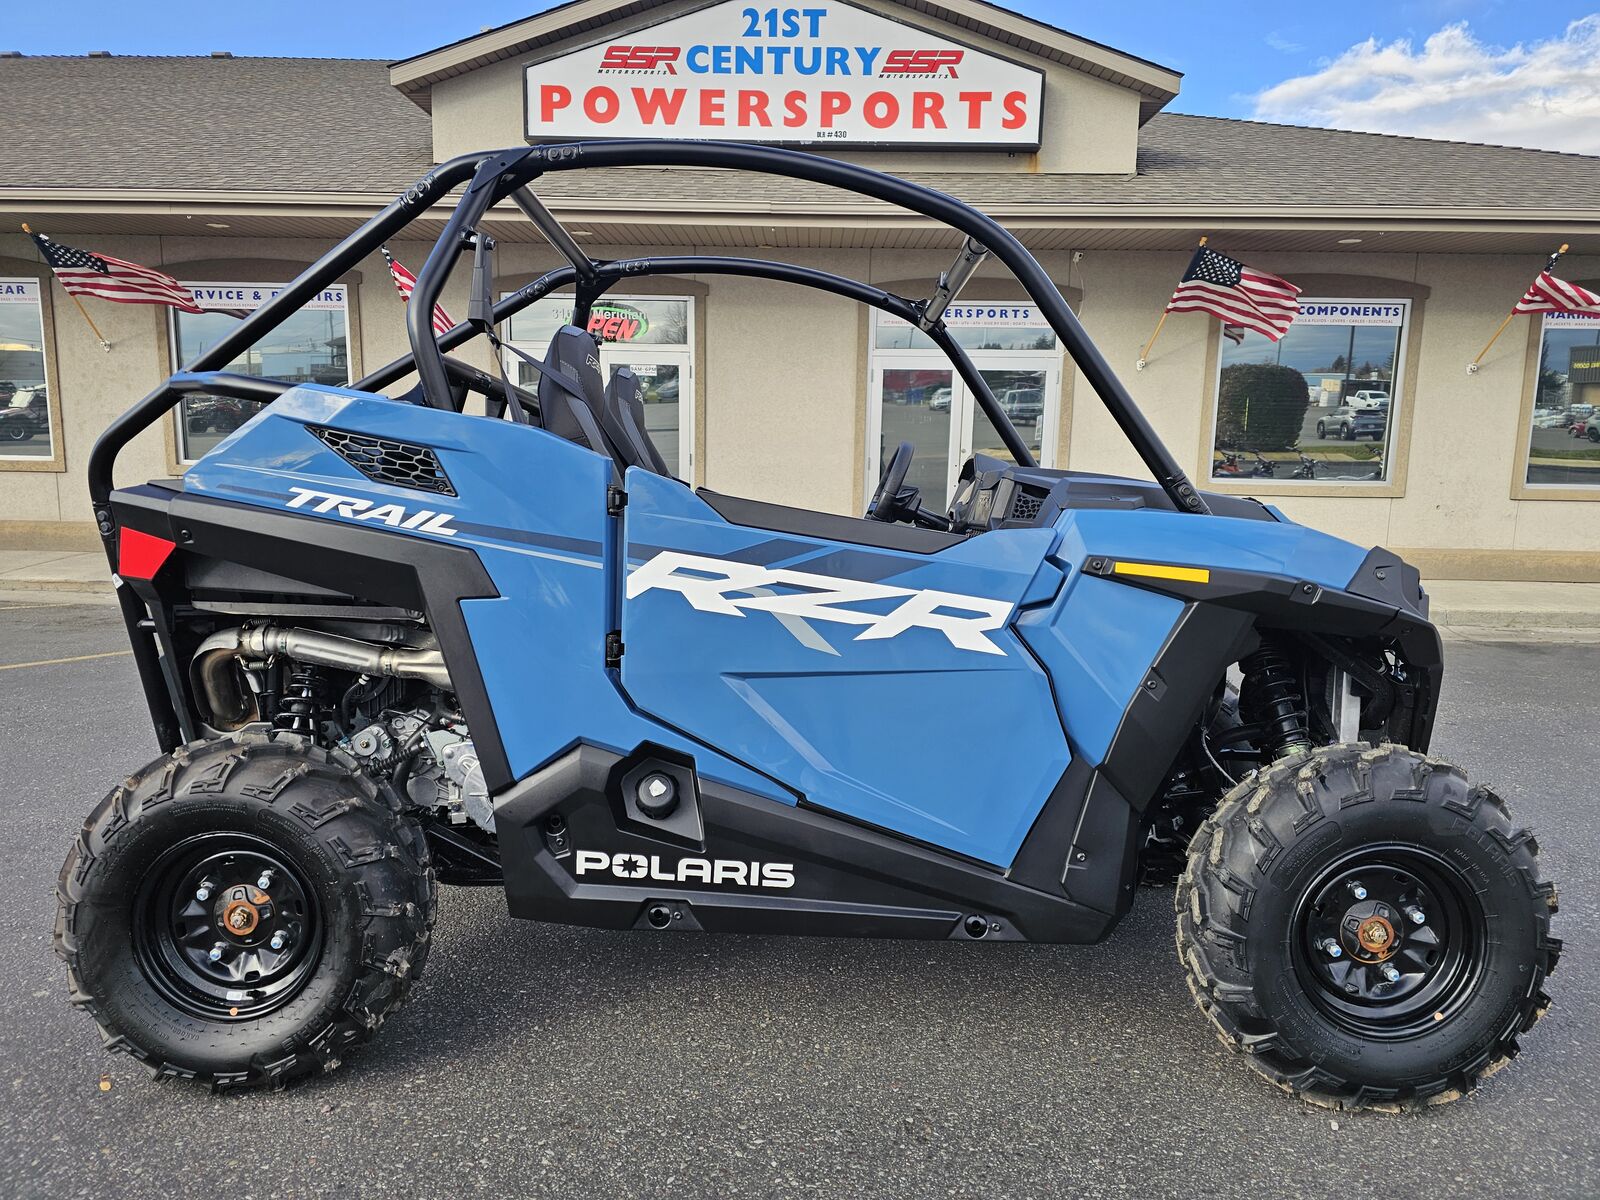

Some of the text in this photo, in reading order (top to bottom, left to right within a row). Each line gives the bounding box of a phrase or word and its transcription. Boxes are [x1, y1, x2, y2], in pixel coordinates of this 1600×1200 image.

[742, 8, 826, 38] 21ST
[599, 46, 681, 76] SSR
[686, 46, 882, 76] CENTURY
[881, 50, 964, 80] SSR
[540, 84, 1027, 130] POWERSPORTS
[194, 290, 244, 301] RVICE
[592, 308, 648, 321] Meridian
[944, 308, 1029, 319] ERSPORTS
[1298, 305, 1400, 317] COMPONENTS
[587, 315, 639, 342] PEN
[285, 487, 457, 537] TRAIL
[626, 550, 1014, 656] RZR
[576, 850, 795, 889] POLARIS
